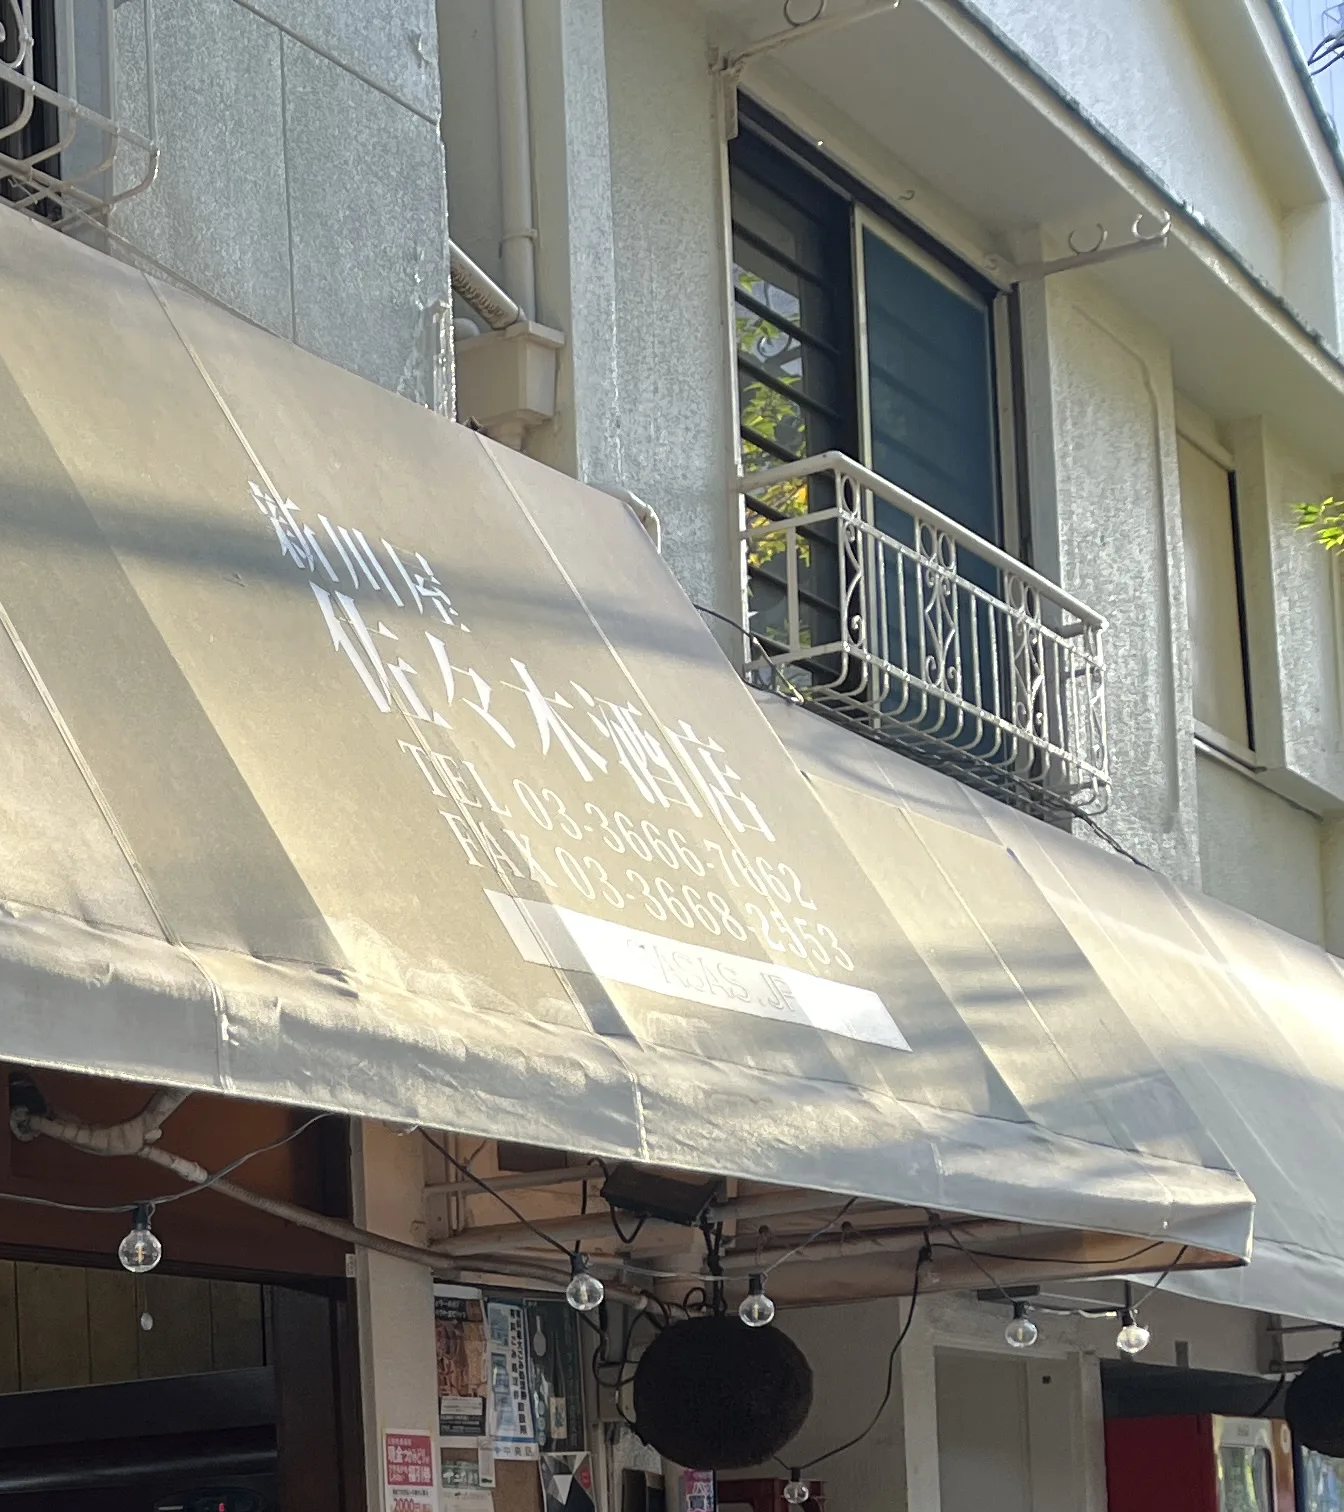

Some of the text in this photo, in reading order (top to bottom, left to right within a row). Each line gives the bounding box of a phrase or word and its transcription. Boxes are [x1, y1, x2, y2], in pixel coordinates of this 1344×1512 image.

[248, 480, 469, 633] 新川屋
[310, 580, 776, 842] 佐々木酒店
[397, 739, 816, 909] TEL 03-3666-7662
[439, 810, 855, 971] FAX 03-3668-2953
